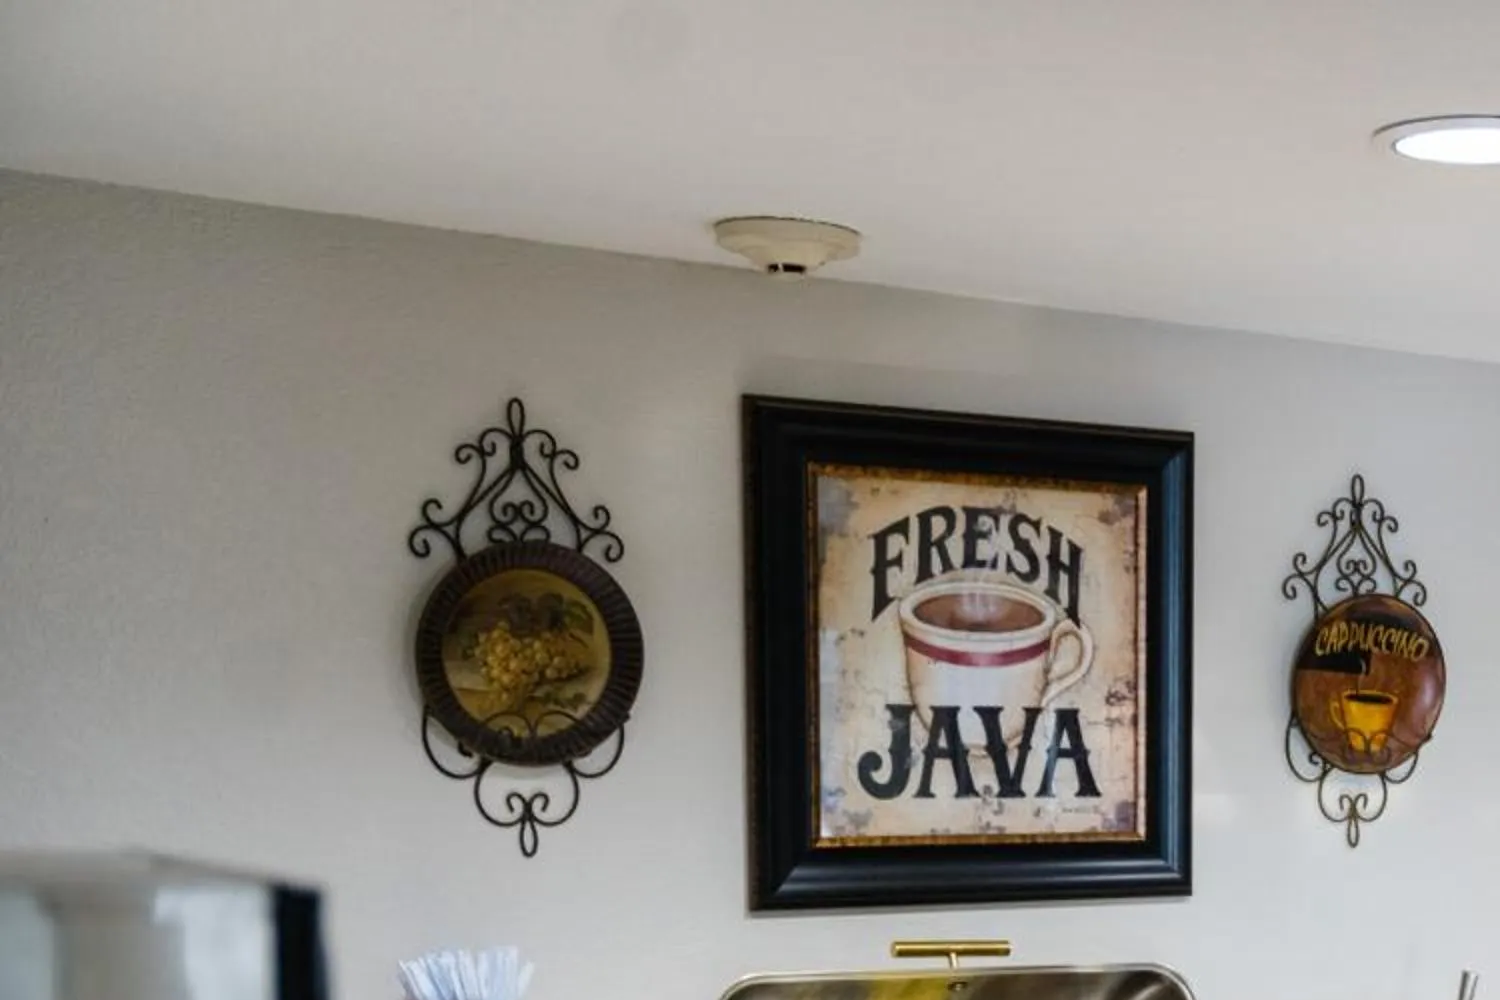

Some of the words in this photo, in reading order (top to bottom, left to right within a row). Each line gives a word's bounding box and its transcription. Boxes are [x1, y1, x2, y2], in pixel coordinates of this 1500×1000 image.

[867, 505, 1085, 630] FRESH
[1315, 620, 1430, 663] CAPPUCCINO
[857, 702, 1102, 801] JAVA
